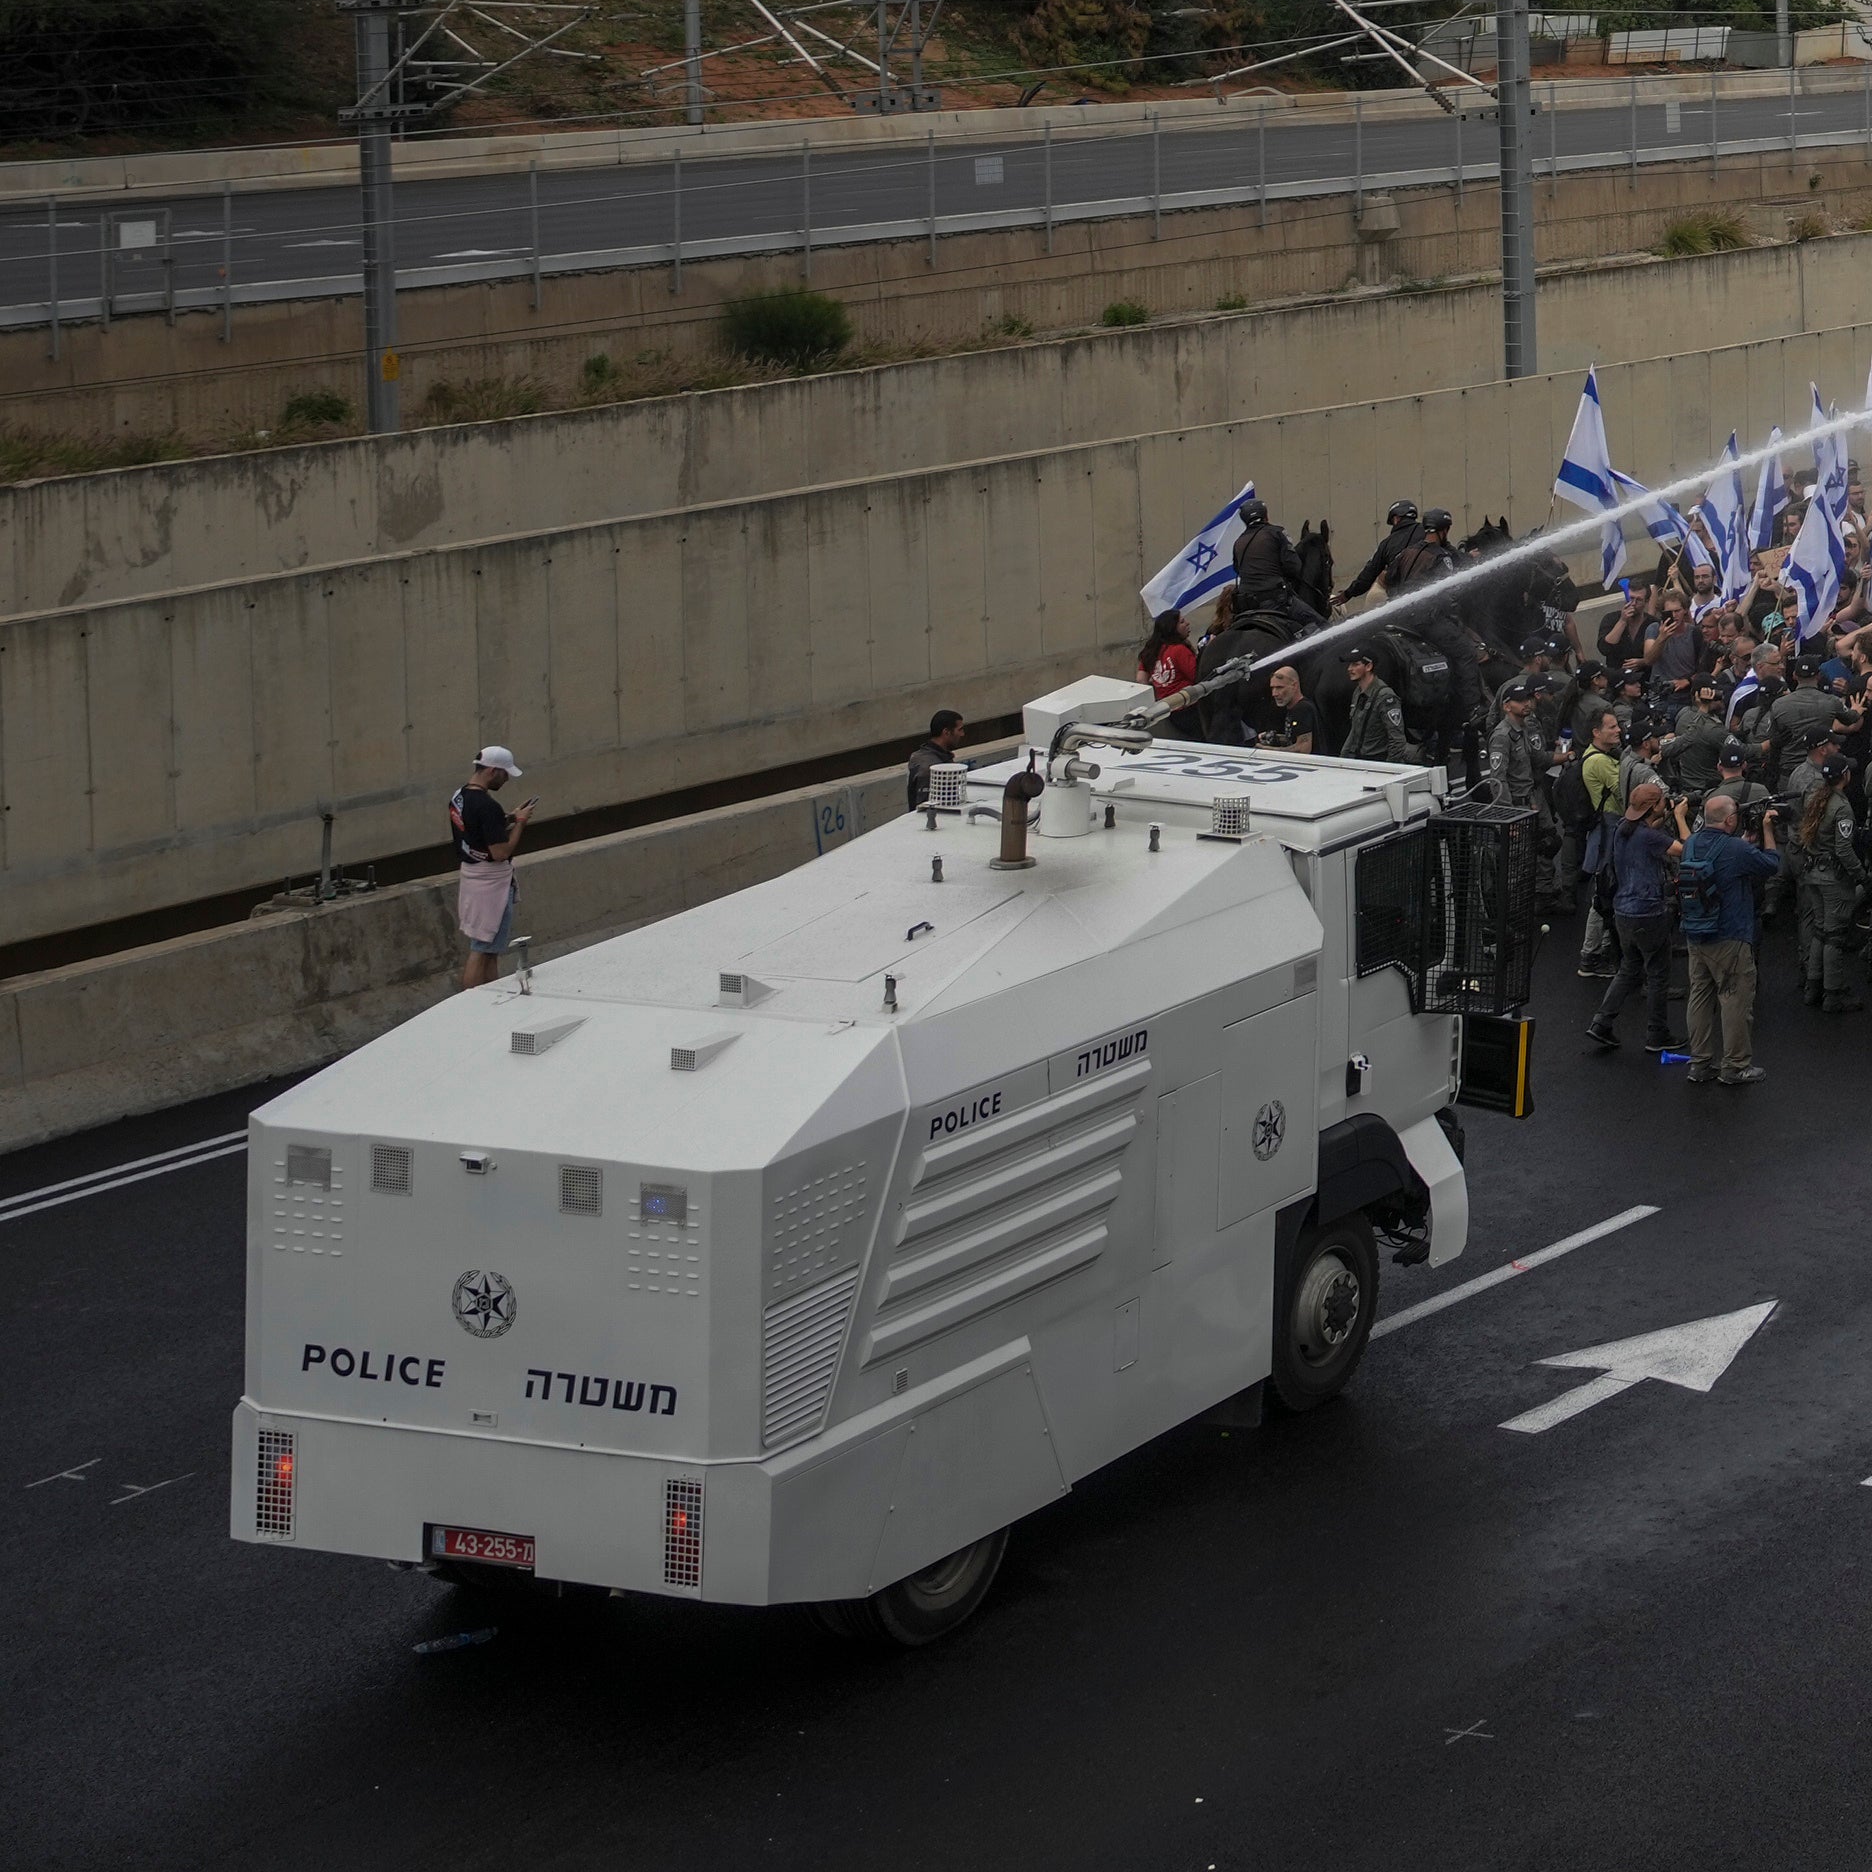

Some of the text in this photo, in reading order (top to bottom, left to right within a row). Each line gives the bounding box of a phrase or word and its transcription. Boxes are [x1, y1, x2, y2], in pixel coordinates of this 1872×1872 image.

[1120, 754, 1319, 784] 255
[1078, 1030, 1148, 1077] משטרה
[930, 1092, 1002, 1140] POLICE
[302, 1344, 446, 1388] POLICE
[525, 1369, 678, 1416] משטרה
